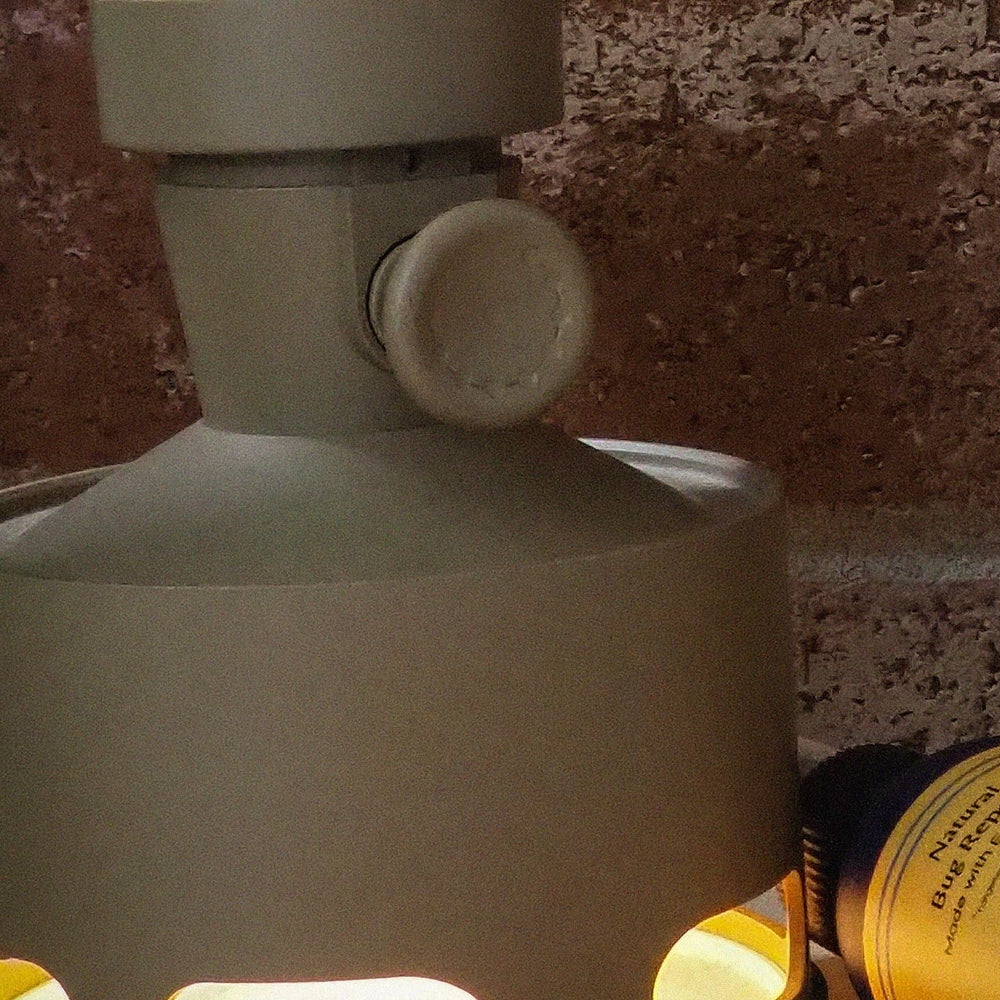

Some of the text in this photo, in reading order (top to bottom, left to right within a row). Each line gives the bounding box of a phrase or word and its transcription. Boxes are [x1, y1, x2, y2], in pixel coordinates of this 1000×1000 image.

[929, 785, 1000, 862] Natural
[931, 859, 966, 910] Bug
[944, 895, 967, 956] Made
[964, 849, 996, 890] with
